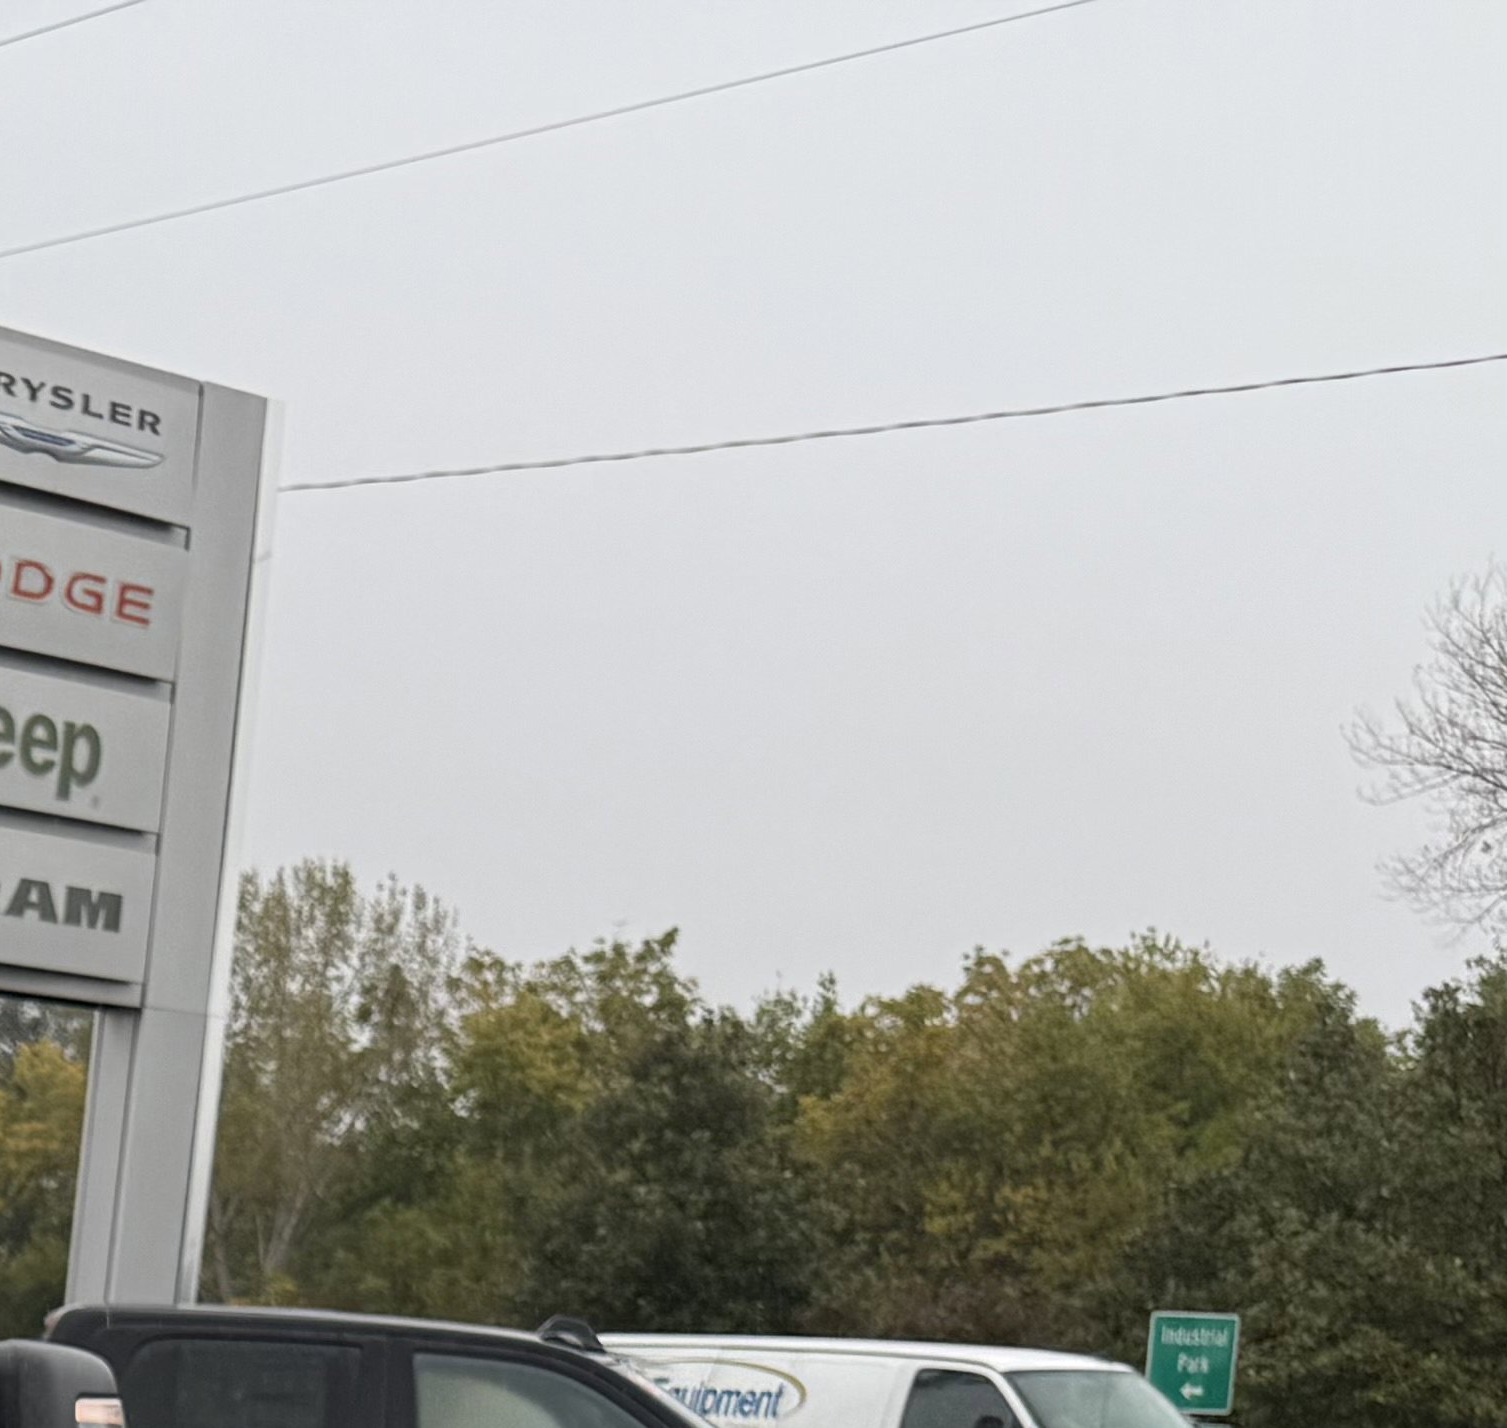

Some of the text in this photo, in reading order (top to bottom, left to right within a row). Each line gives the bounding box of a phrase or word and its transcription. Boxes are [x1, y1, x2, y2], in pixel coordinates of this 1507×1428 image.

[1161, 1326, 1228, 1347] Industrial
[1177, 1352, 1210, 1374] Park
[653, 1377, 786, 1419] uipment
